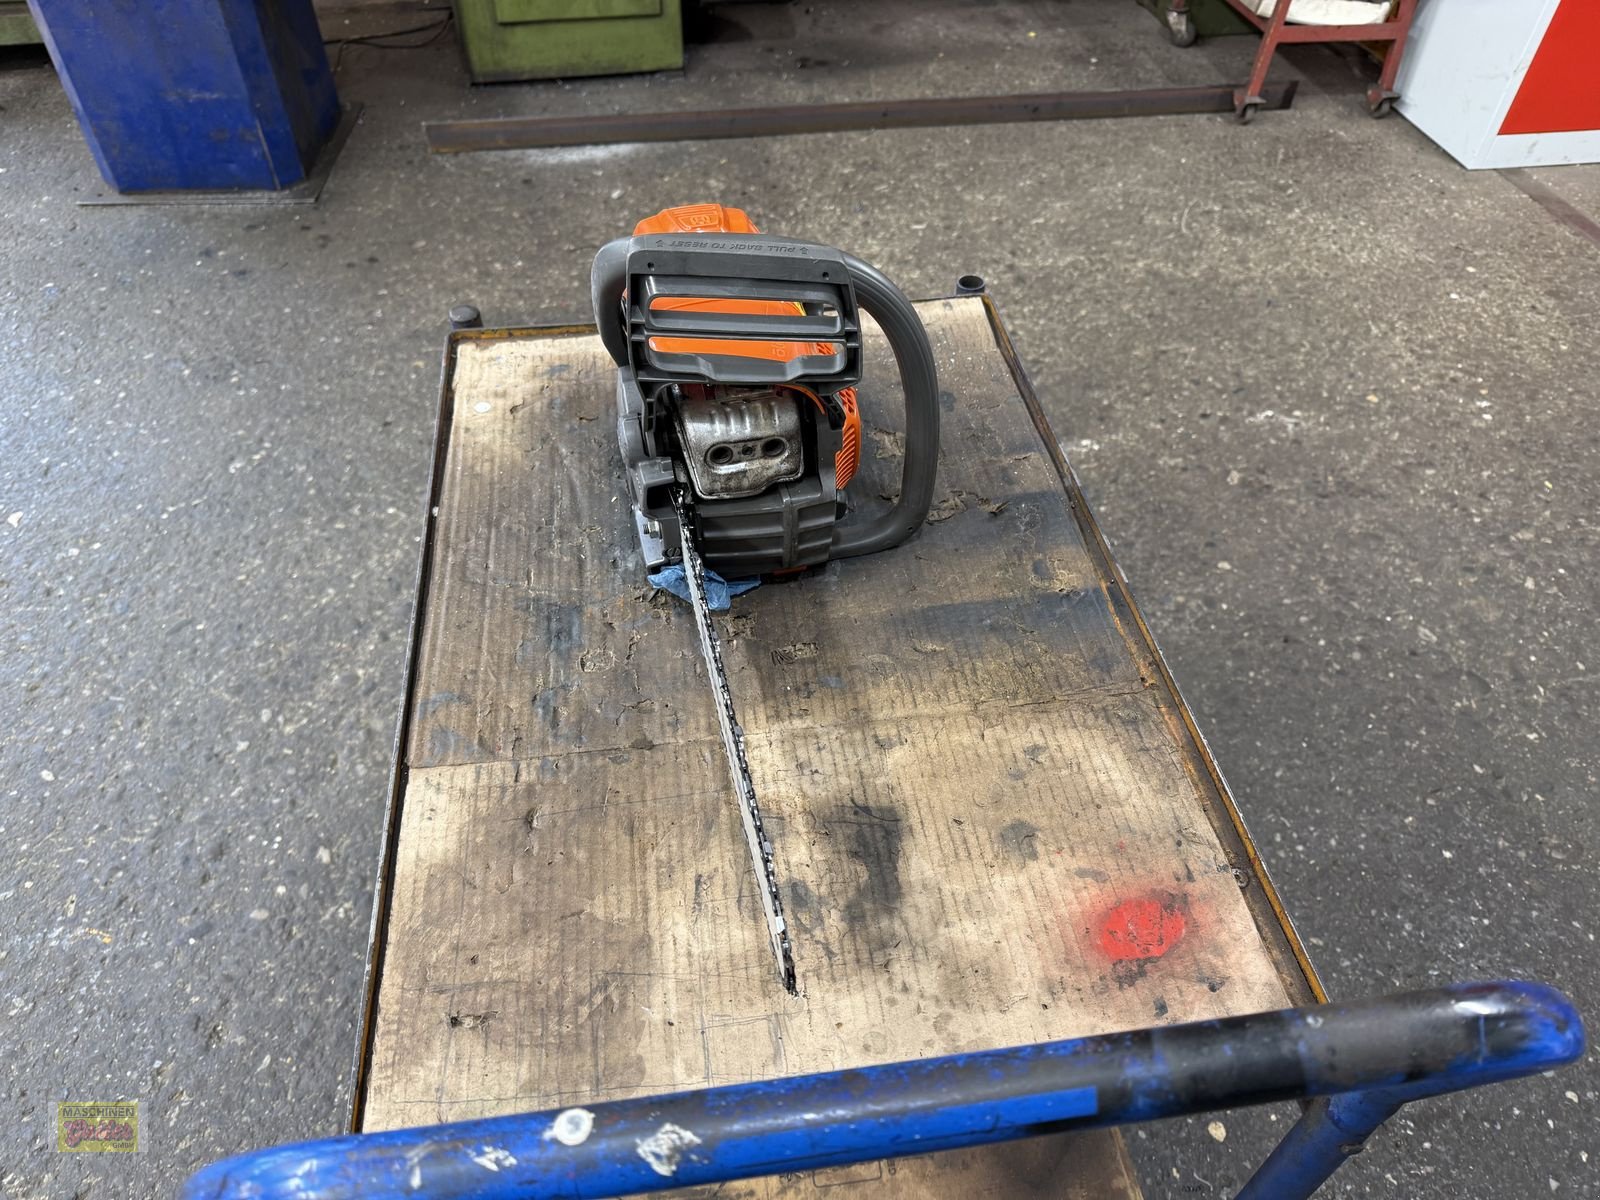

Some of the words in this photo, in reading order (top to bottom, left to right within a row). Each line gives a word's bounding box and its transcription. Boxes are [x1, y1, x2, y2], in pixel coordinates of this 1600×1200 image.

[668, 240, 709, 248] RESET
[711, 242, 726, 250] TO
[729, 242, 763, 251] BACK
[767, 245, 796, 253] PULL
